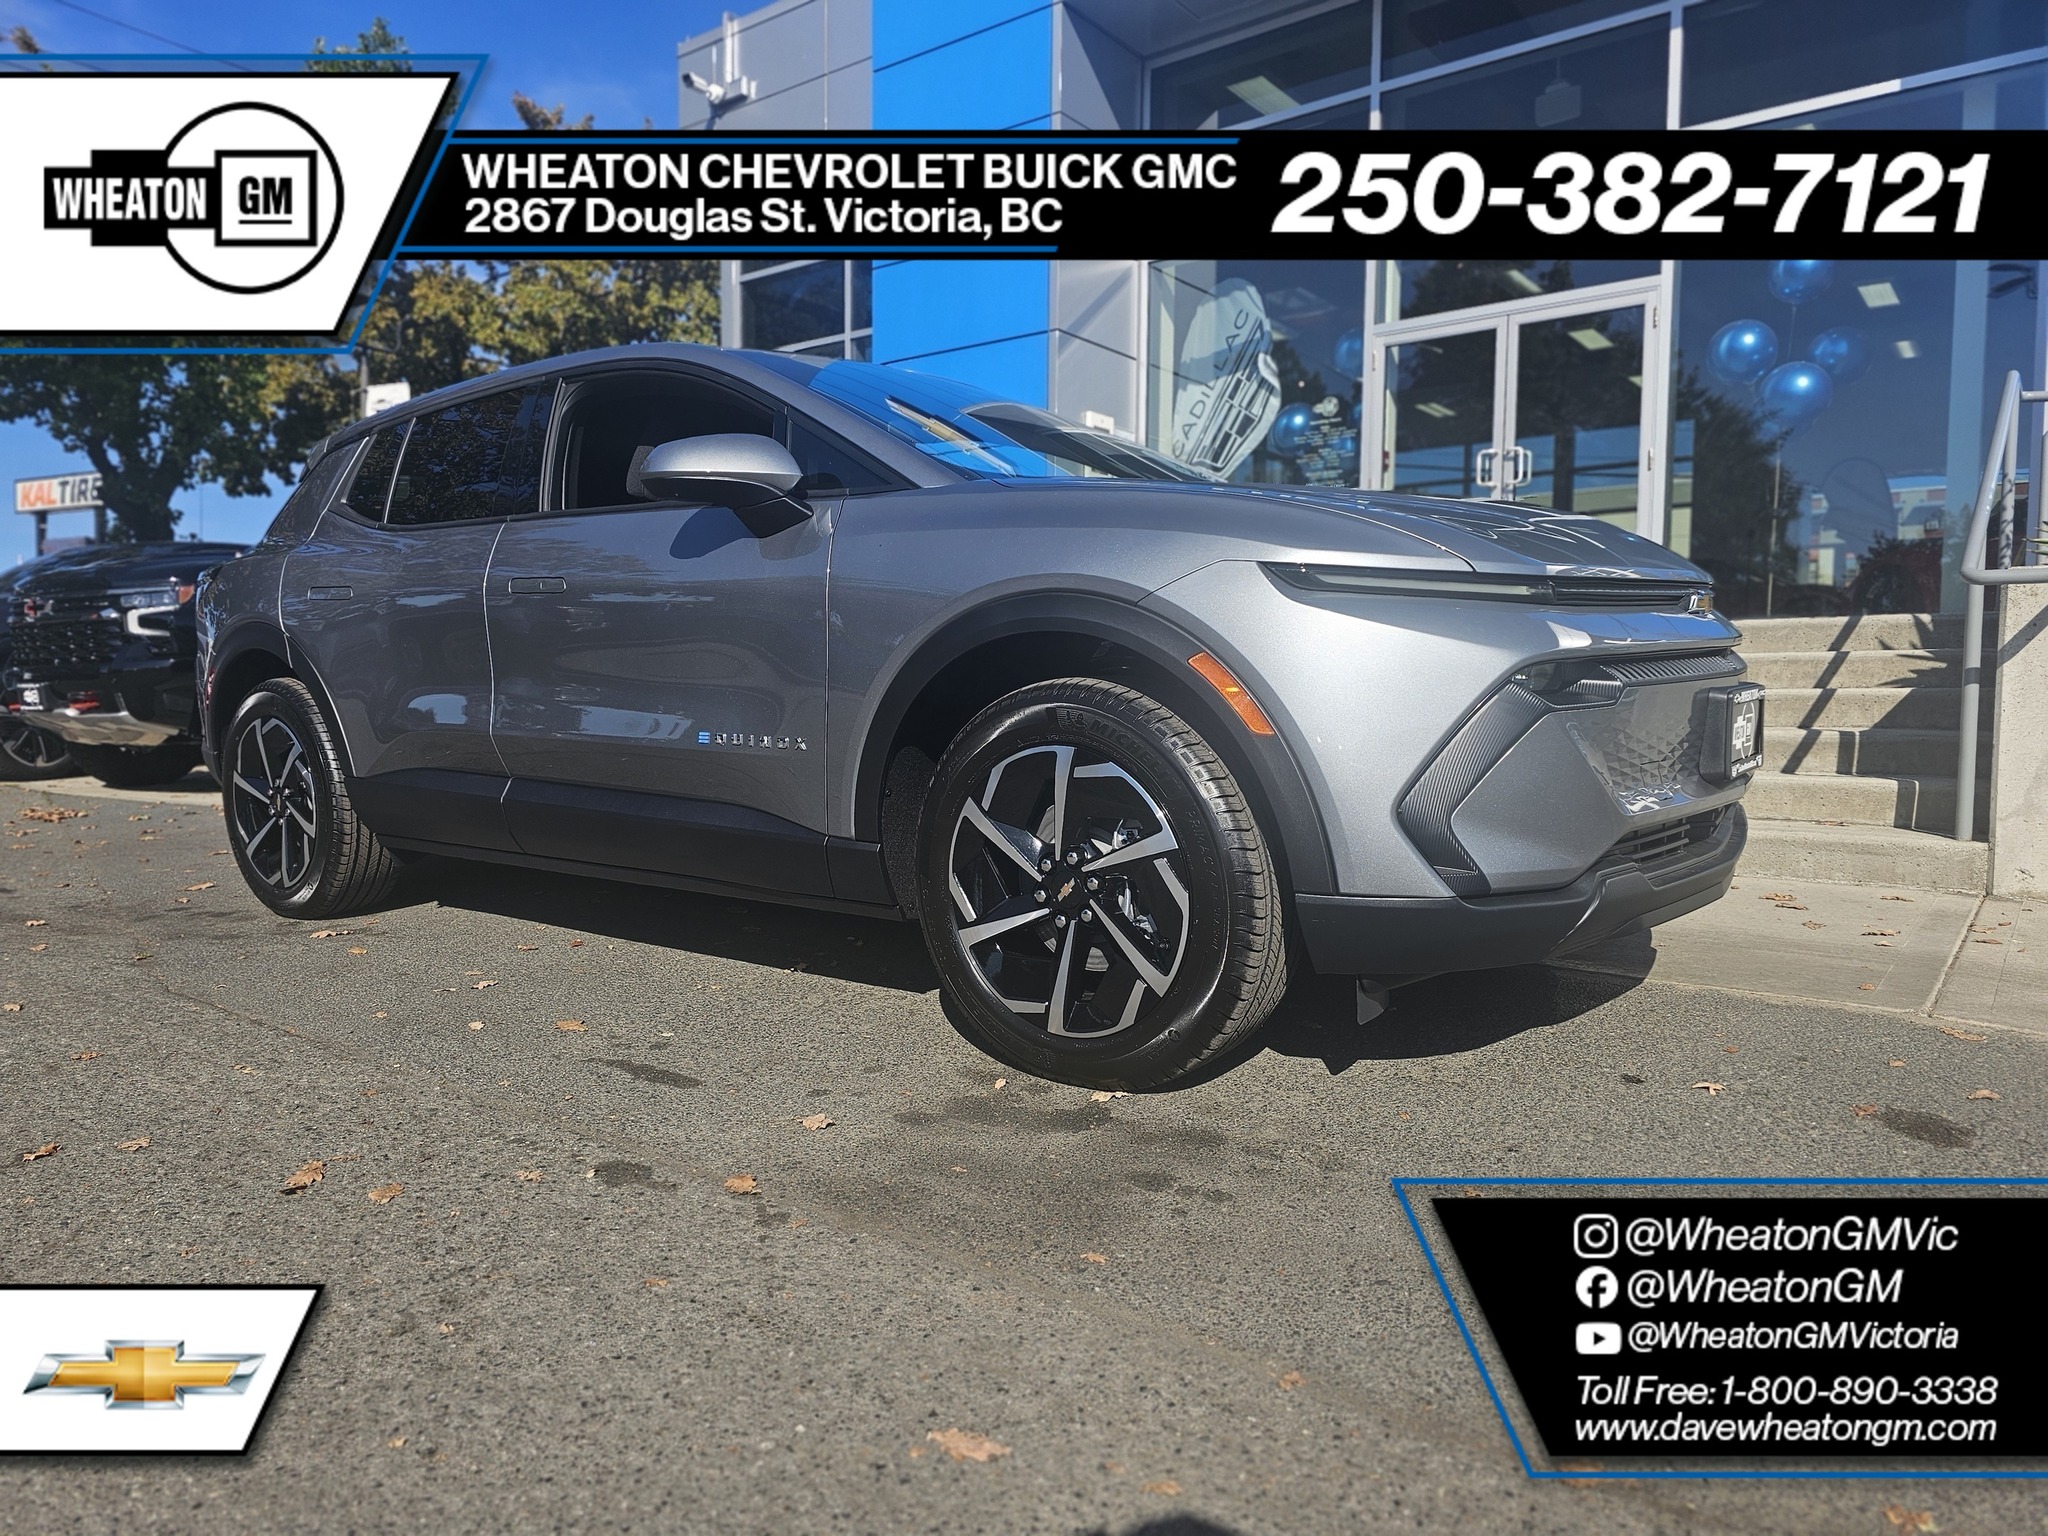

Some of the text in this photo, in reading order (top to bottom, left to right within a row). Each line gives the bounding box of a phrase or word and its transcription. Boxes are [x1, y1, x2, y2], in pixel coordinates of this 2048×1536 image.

[1171, 308, 1250, 459] CADILLAC
[20, 480, 57, 508] KAL
[698, 731, 808, 751] EQUINOX
